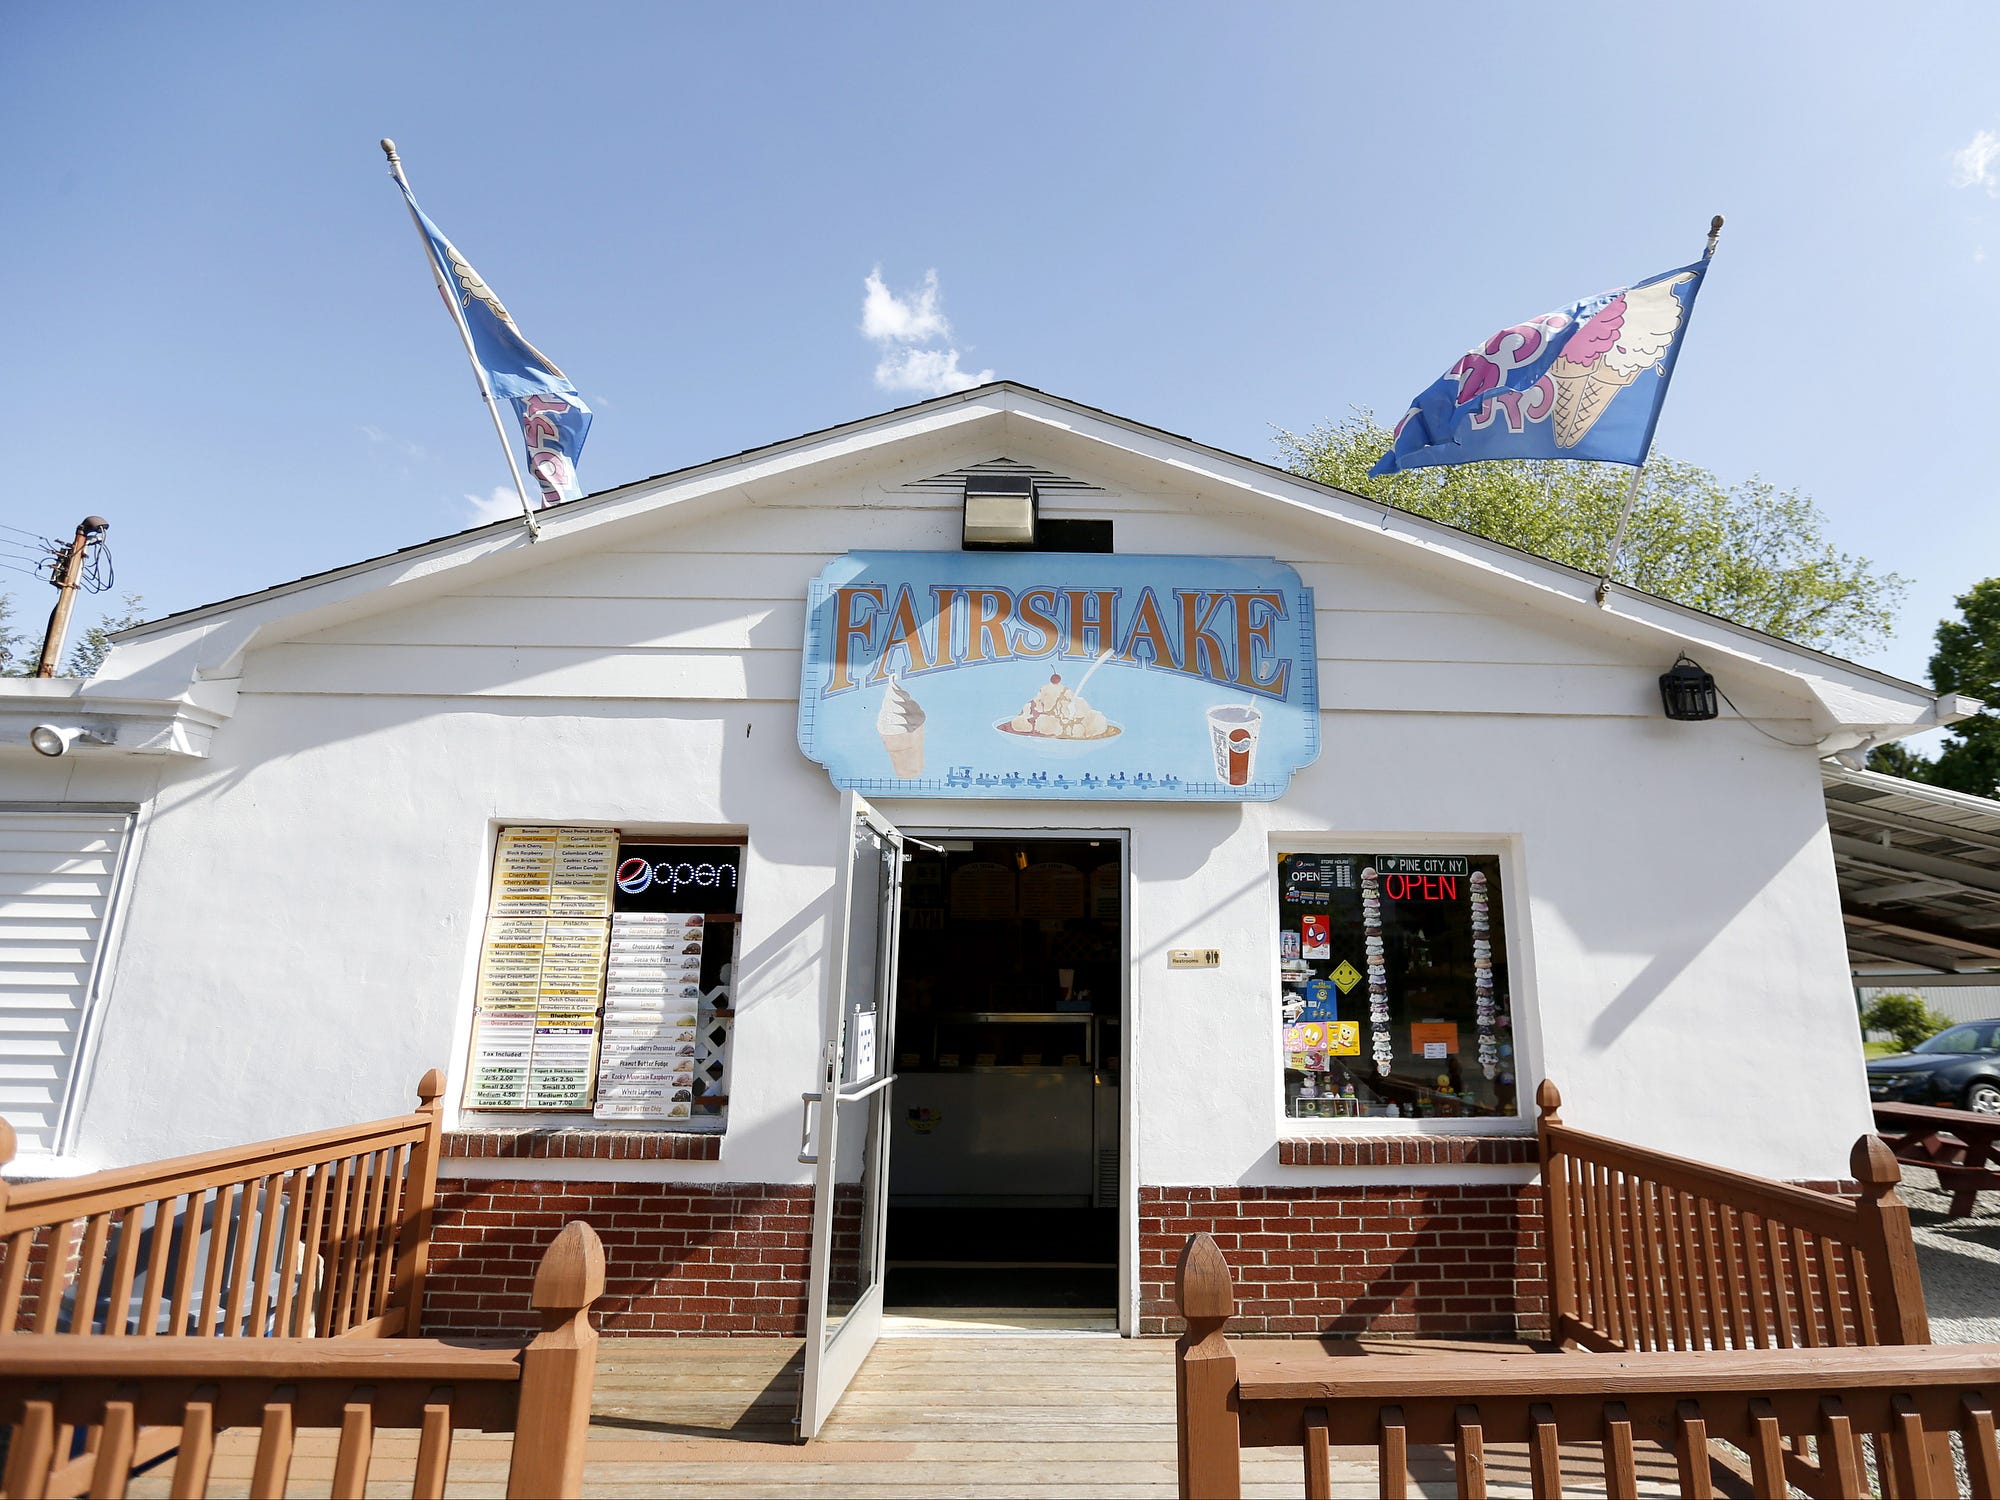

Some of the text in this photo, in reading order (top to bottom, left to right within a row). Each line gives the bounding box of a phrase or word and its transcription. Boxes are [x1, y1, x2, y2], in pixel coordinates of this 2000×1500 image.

[820, 582, 1291, 702] FAIRSHAKE
[653, 862, 737, 893] open
[1291, 871, 1320, 881] OPEN
[1380, 858, 1463, 872] I PINE CITY, NY
[1386, 874, 1457, 900] OPEN
